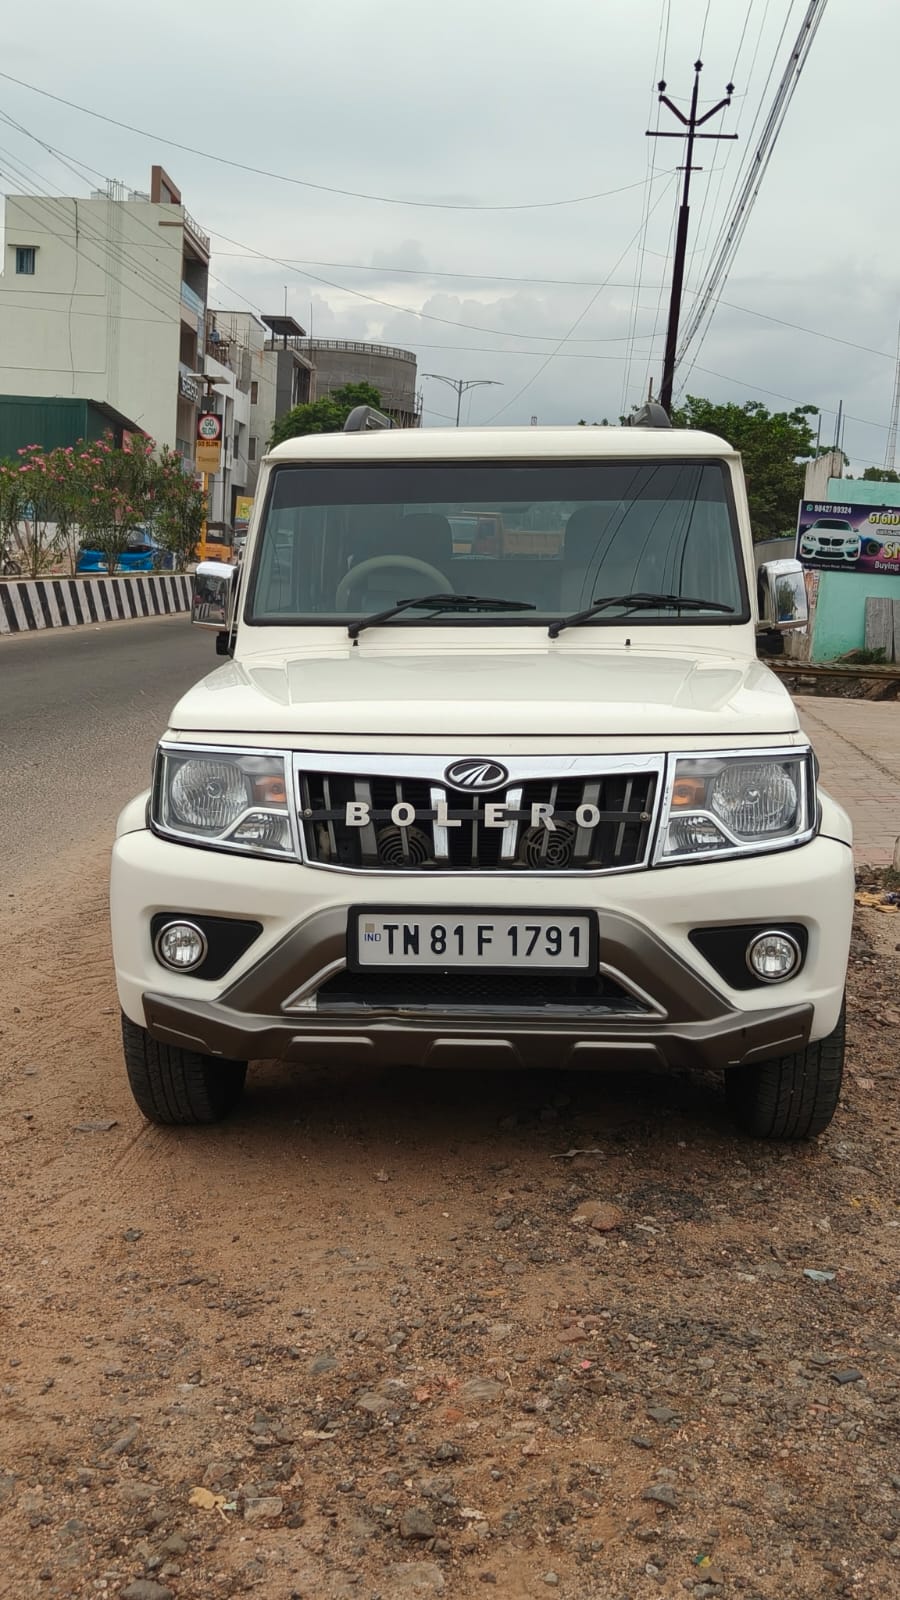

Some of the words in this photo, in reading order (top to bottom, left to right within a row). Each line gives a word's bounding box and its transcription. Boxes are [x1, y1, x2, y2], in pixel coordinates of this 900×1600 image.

[204, 419, 214, 427] GO
[202, 427, 217, 435] SLOW
[874, 560, 900, 571] Buying
[345, 801, 601, 831] BOLERO
[364, 933, 381, 942] IND
[383, 923, 419, 956] TN
[430, 924, 464, 956] 81
[477, 925, 494, 956] F
[507, 925, 581, 958] 1791
